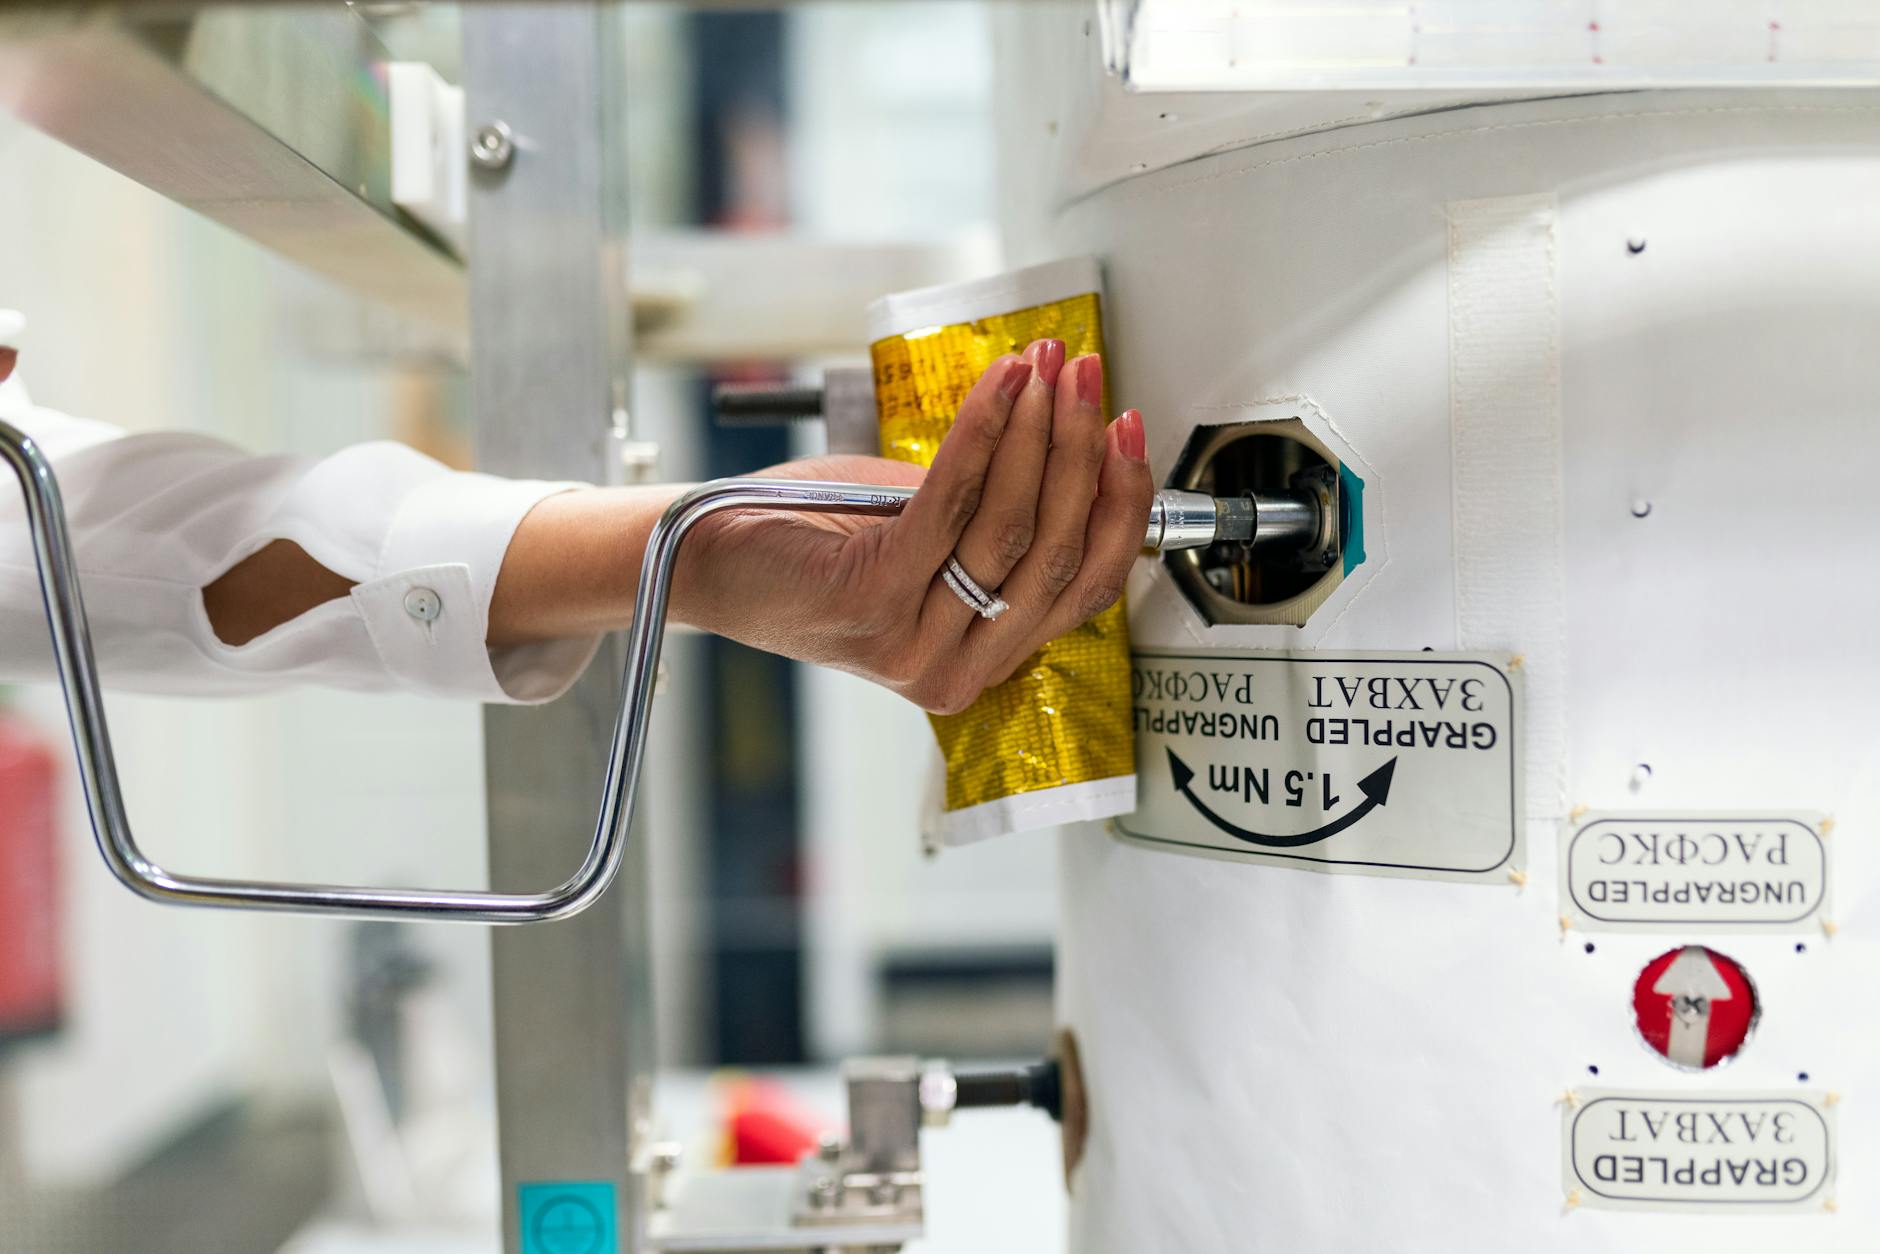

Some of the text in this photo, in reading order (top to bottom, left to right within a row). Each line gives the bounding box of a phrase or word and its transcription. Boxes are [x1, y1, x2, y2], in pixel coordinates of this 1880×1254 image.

[1308, 676, 1485, 711] ЗАХВАТ
[1133, 706, 1279, 741] UNGRAPPL
[1306, 718, 1496, 750] GRAPPLED
[1209, 764, 1340, 811] 1.5 Nm
[1599, 833, 1789, 865] РАСФКС
[1588, 880, 1805, 904] UNGRAPPLED
[1608, 1110, 1795, 1144] ЗАХВАТ
[1593, 1154, 1808, 1186] GRAPPLED
